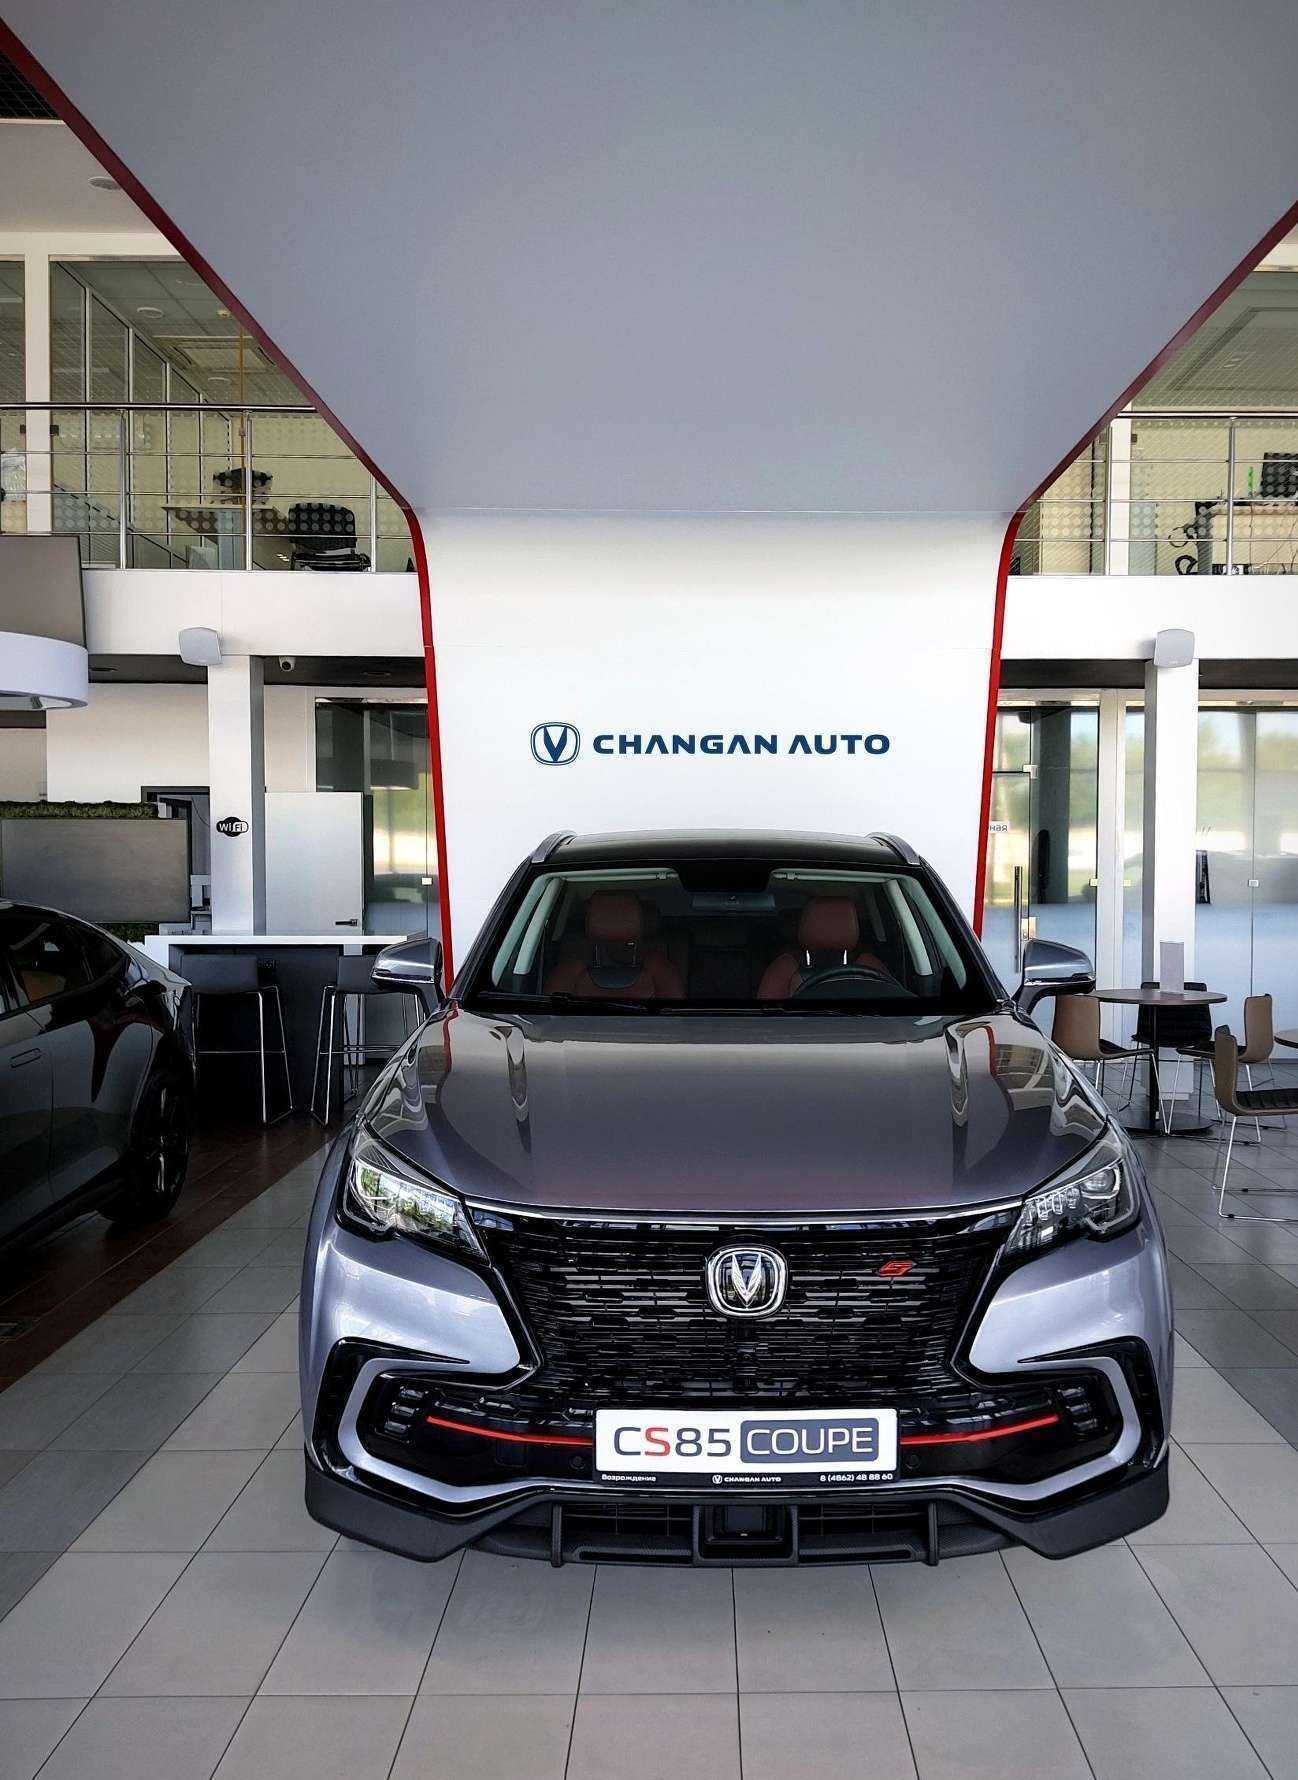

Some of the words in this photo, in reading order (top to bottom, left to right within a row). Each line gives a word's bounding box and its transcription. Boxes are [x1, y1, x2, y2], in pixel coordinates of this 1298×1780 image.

[593, 734, 778, 755] CHANGAN
[788, 734, 890, 755] AUTO
[613, 1426, 732, 1457] CS85
[746, 1427, 874, 1455] COUPE
[601, 1473, 657, 1482] Возрождение
[820, 1474, 827, 1482] 8
[827, 1474, 855, 1482] (4862)
[855, 1473, 868, 1481] 48
[868, 1473, 881, 1481] 88
[881, 1472, 894, 1480] 60
